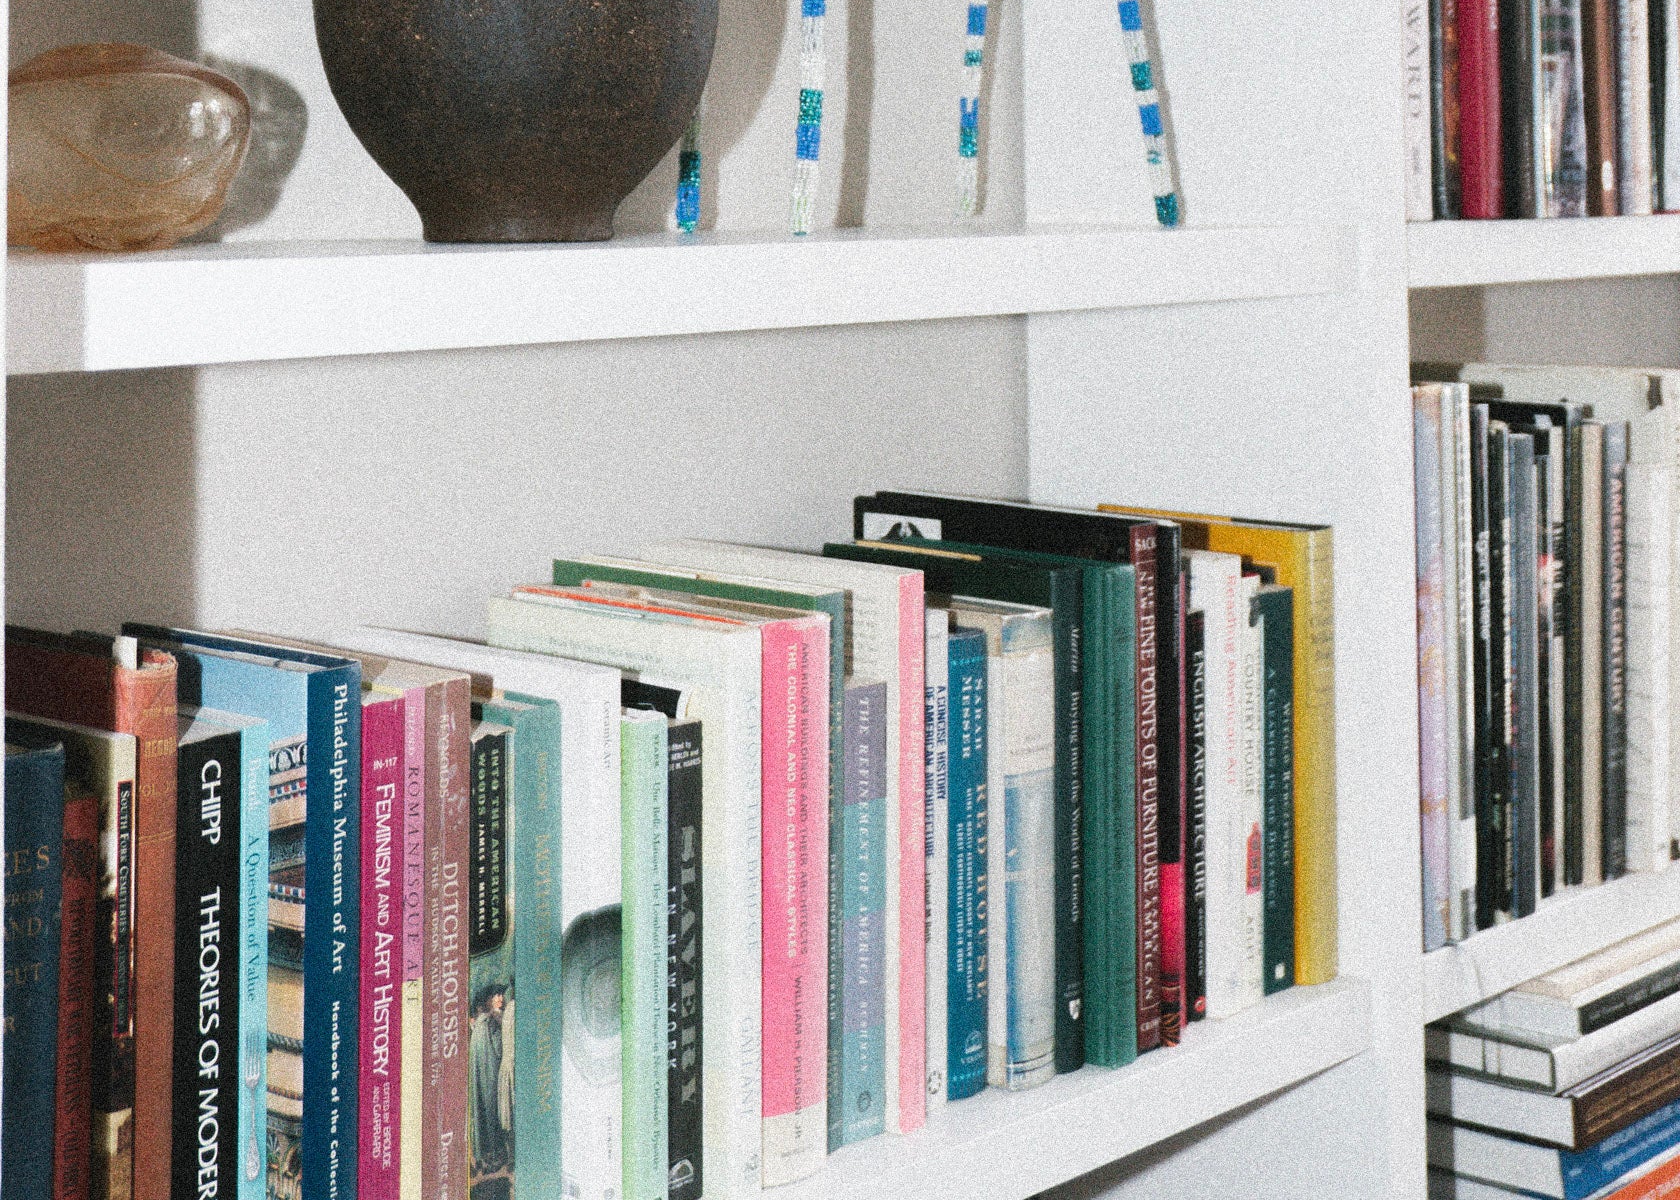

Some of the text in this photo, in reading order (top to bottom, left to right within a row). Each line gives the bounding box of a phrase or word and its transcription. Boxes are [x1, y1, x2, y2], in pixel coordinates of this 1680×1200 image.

[1070, 624, 1080, 673] Martin
[1610, 478, 1623, 714] AMERICAN CENTURY
[603, 699, 613, 770] Ceramic Art
[859, 697, 870, 735] THE
[937, 696, 946, 746] CONCISE
[962, 676, 973, 759] MESSER
[975, 678, 984, 750] SARAH
[1069, 690, 1079, 744] Buying
[1226, 574, 1239, 785] Reading American Art
[1245, 653, 1256, 800] COUNTRY HOUSE
[787, 643, 797, 958] THE COLONIAL AND CLASSICAL STYLES
[800, 643, 810, 956] AMERICAN BUILDINGS AND THEIR ARCHITECTS
[859, 744, 870, 863] REFINEMENT
[907, 653, 924, 852] The New England Village
[926, 704, 936, 858] AMERICAN ARCHITECTURE
[937, 751, 946, 800] HISTORY
[1071, 747, 1079, 775] into
[1071, 779, 1080, 803] the
[1140, 614, 1158, 893] FINE POINTS OF FURNITURE
[1193, 650, 1206, 902] ENGLISH ARCHITECTURE
[1267, 687, 1278, 909] CLEARING THE DISTANCE
[119, 790, 130, 934] SOUTH FORK CEMETERIES
[404, 766, 420, 1006] ROMANESQUE ART
[432, 846, 439, 861] IN
[439, 714, 459, 1060] REYNOLDS HOUSES
[478, 753, 487, 935] WOODS JAMES MERRELL
[491, 749, 500, 930] INTO THE AMERICAN
[860, 872, 870, 894] OF
[1071, 807, 1081, 851] World
[245, 833, 260, 1002] A Question of Value
[329, 684, 349, 1134] Philadelphia Museum of Art Handbook of the
[372, 783, 396, 1077] FEMINISM AND ART HISTORY
[432, 897, 440, 953] HUDSON
[860, 905, 870, 985] AMERICA
[1071, 874, 1081, 921] Goods
[1143, 898, 1153, 1001] AMERICAN
[197, 759, 222, 1200] CHIPP THEORIES OF MODER
[432, 956, 440, 1004] VALLEY
[432, 1012, 440, 1058] BEFORE
[654, 952, 663, 1006] Plantation
[668, 886, 677, 1069] IN NEW YORK
[795, 974, 803, 1116] WILLIAM PIERSON
[440, 1131, 454, 1182] Dover
